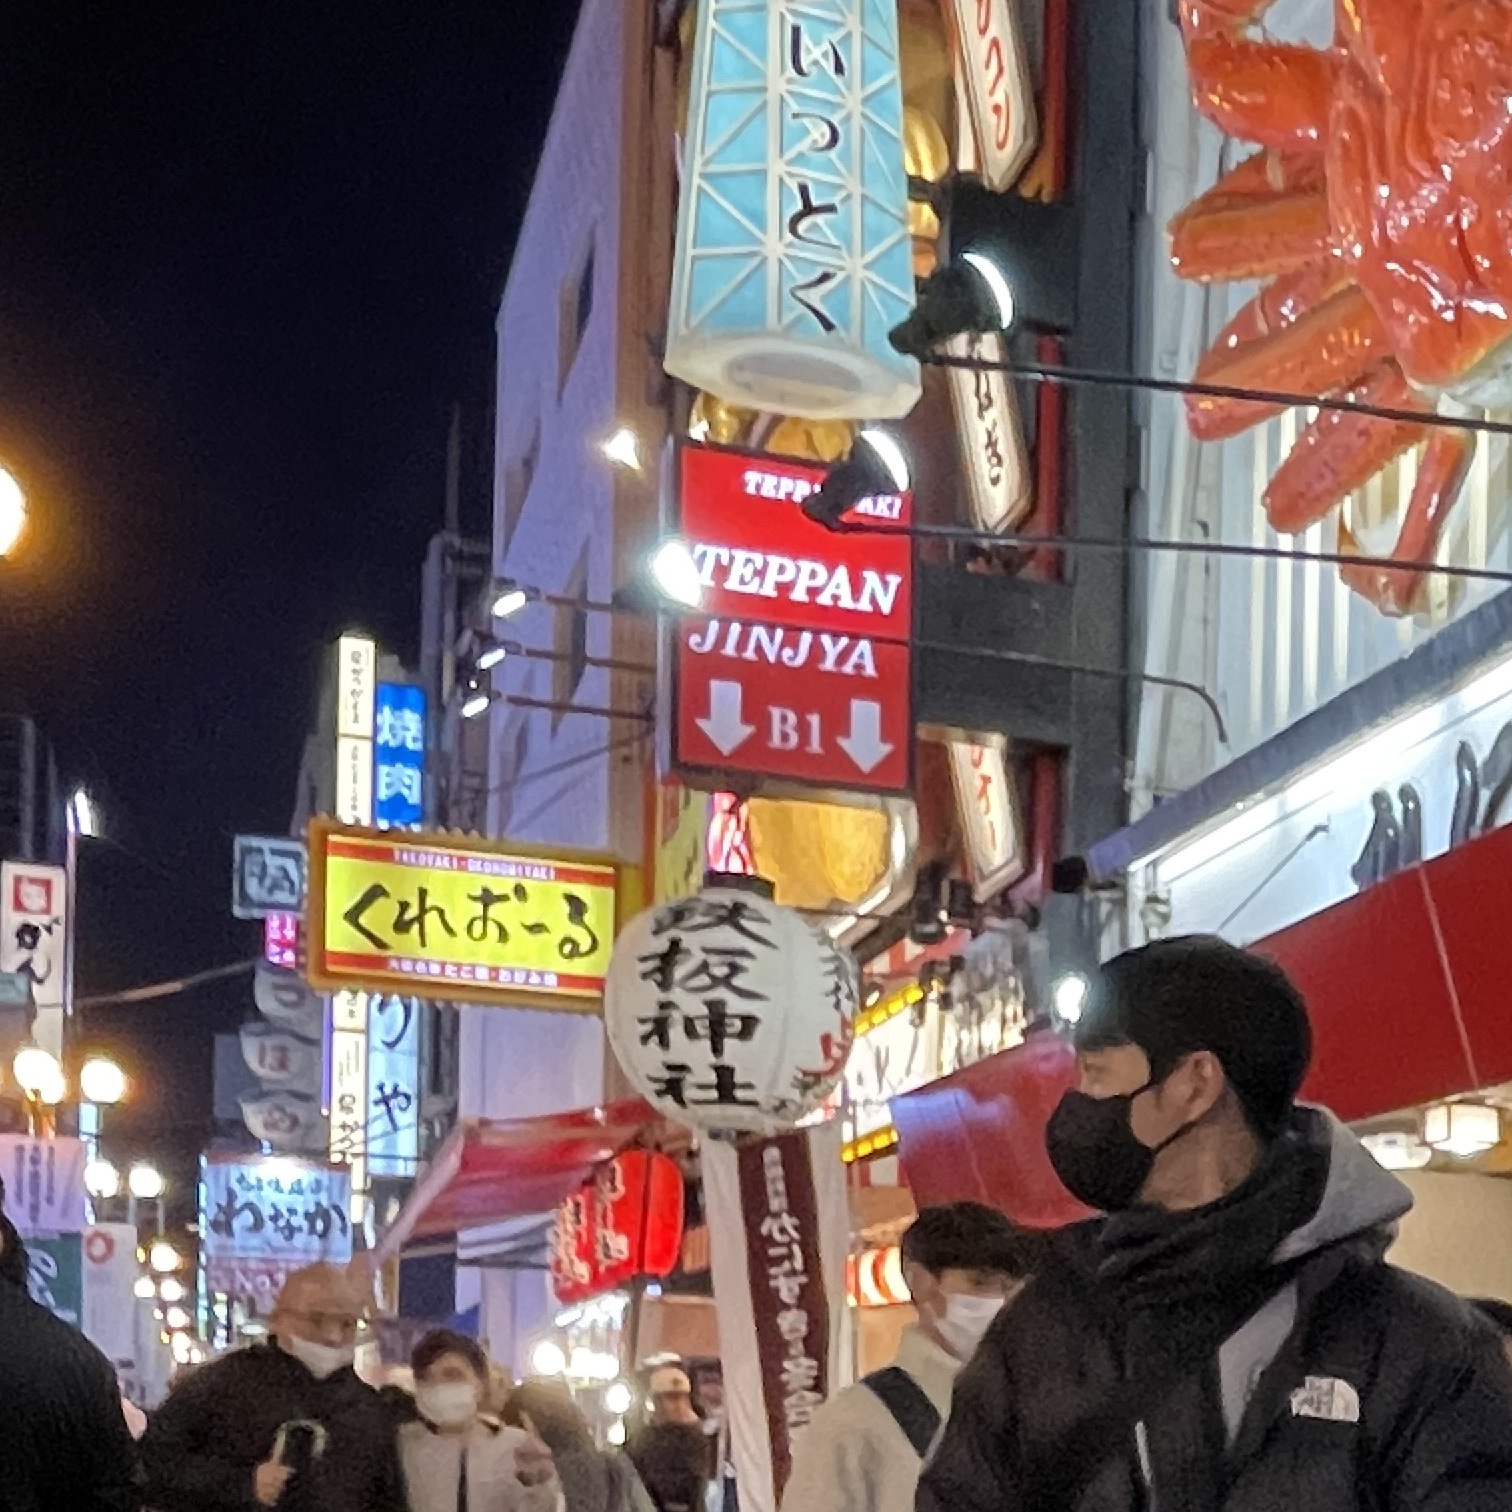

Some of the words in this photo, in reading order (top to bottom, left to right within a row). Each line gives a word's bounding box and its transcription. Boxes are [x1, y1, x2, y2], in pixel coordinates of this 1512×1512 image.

[743, 470, 902, 519] TEPPAKI
[693, 544, 902, 616] TEPPAN
[688, 620, 879, 678] JINJYA
[376, 704, 424, 806] 焼肉
[767, 705, 826, 754] B1
[342, 882, 599, 960] くれおーる
